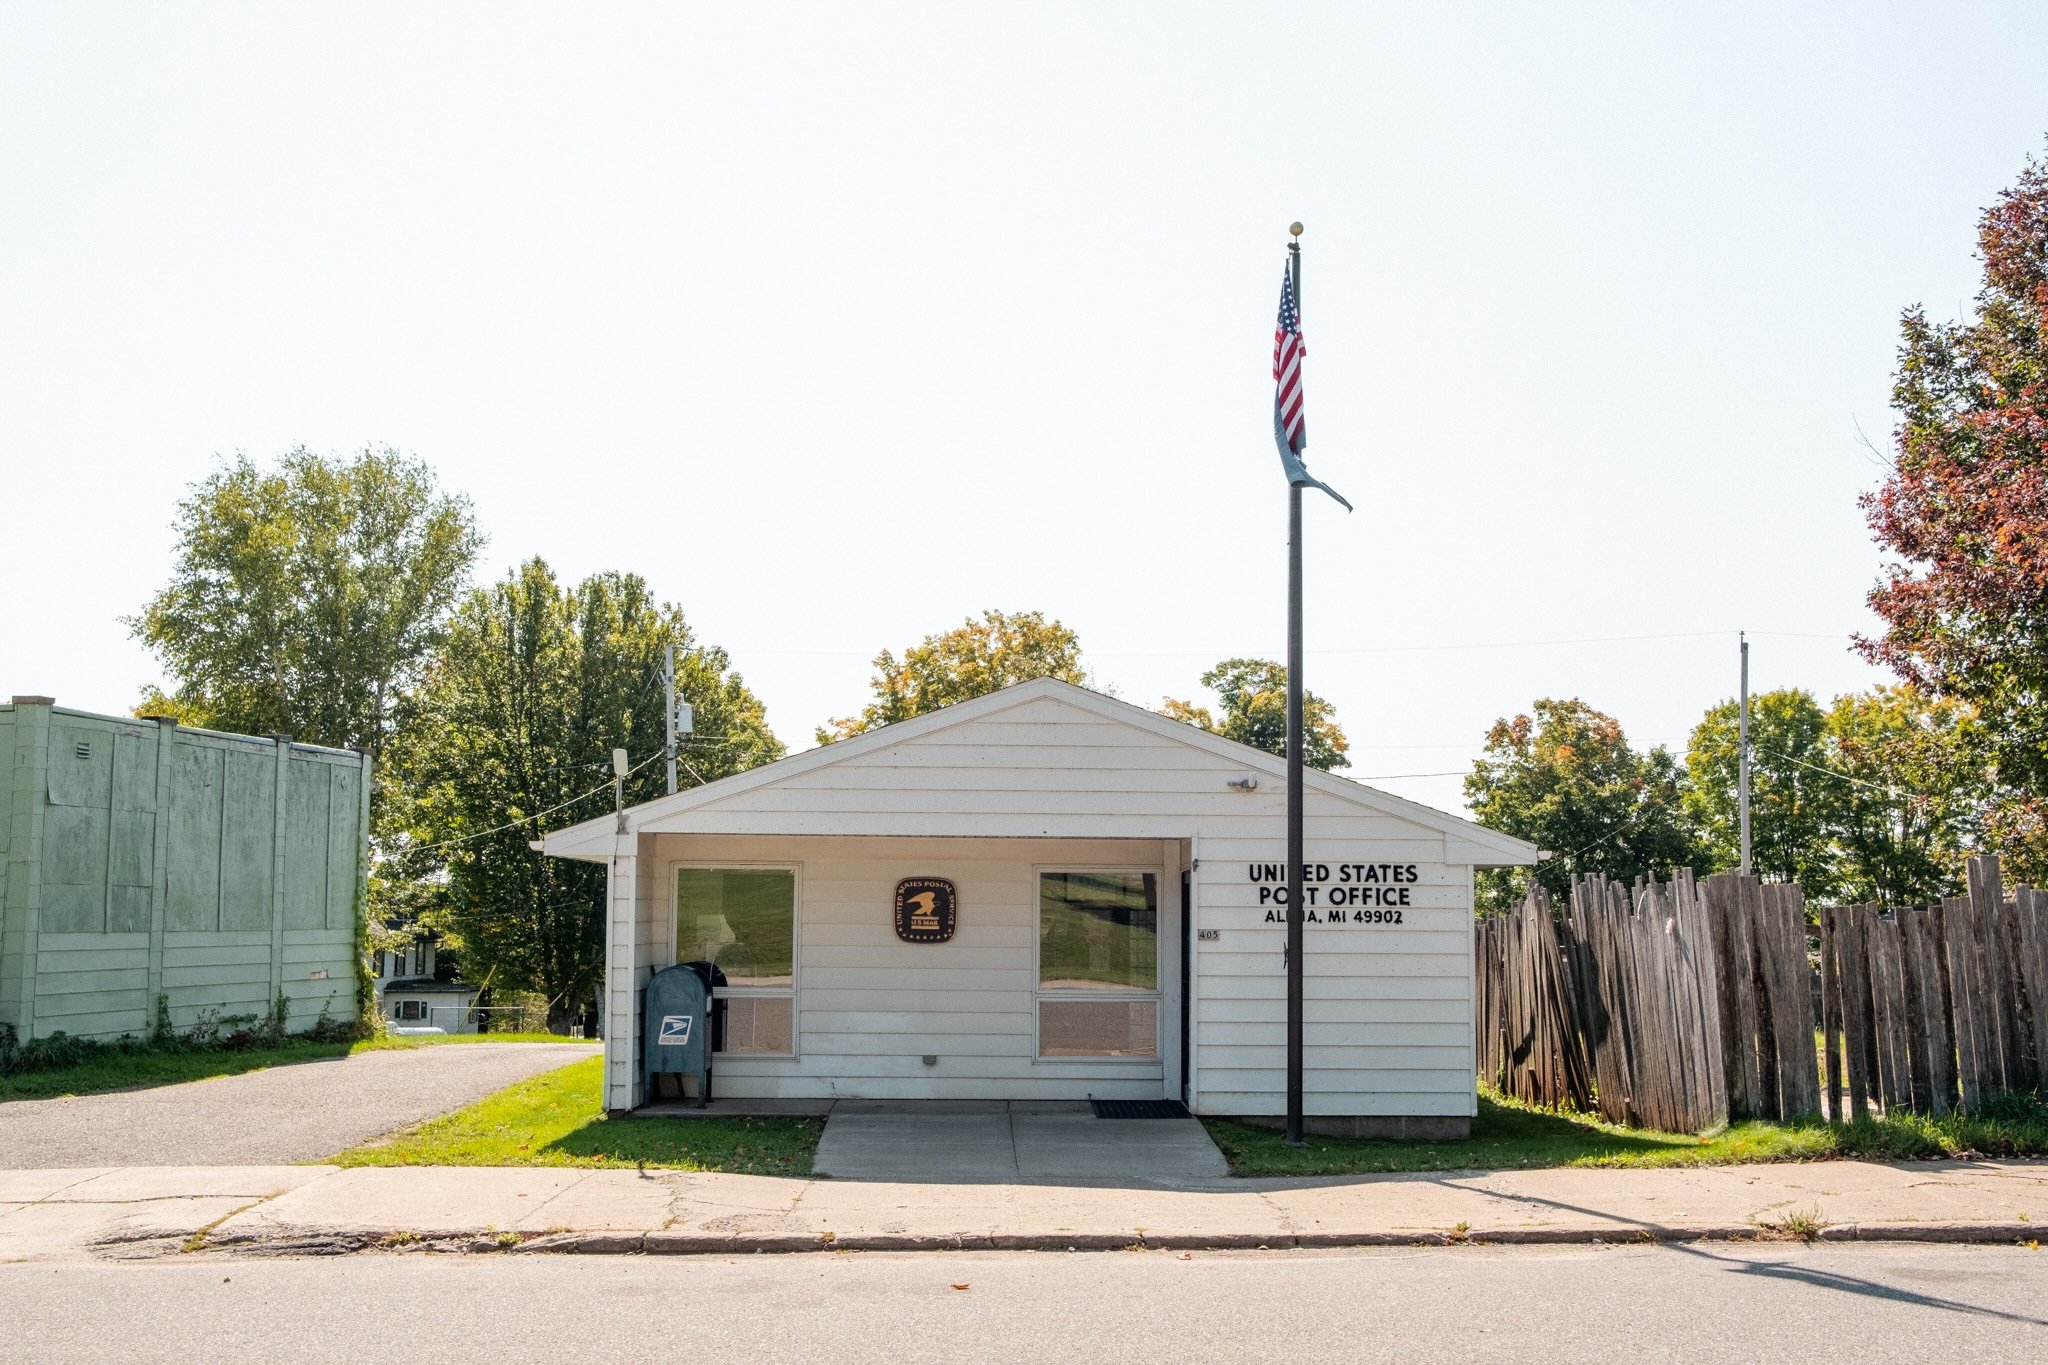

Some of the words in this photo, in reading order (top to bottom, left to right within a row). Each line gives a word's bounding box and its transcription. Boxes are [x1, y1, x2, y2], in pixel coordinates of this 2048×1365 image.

[1249, 864, 1330, 882] UNIED
[1339, 864, 1418, 883] STATES
[898, 881, 922, 894] STATES
[924, 881, 952, 893] POSTAL
[1260, 886, 1319, 905] POT
[1329, 887, 1411, 906] OFFICE
[1328, 910, 1346, 923] MI
[1353, 910, 1403, 924] 49902
[1199, 930, 1218, 940] 405
